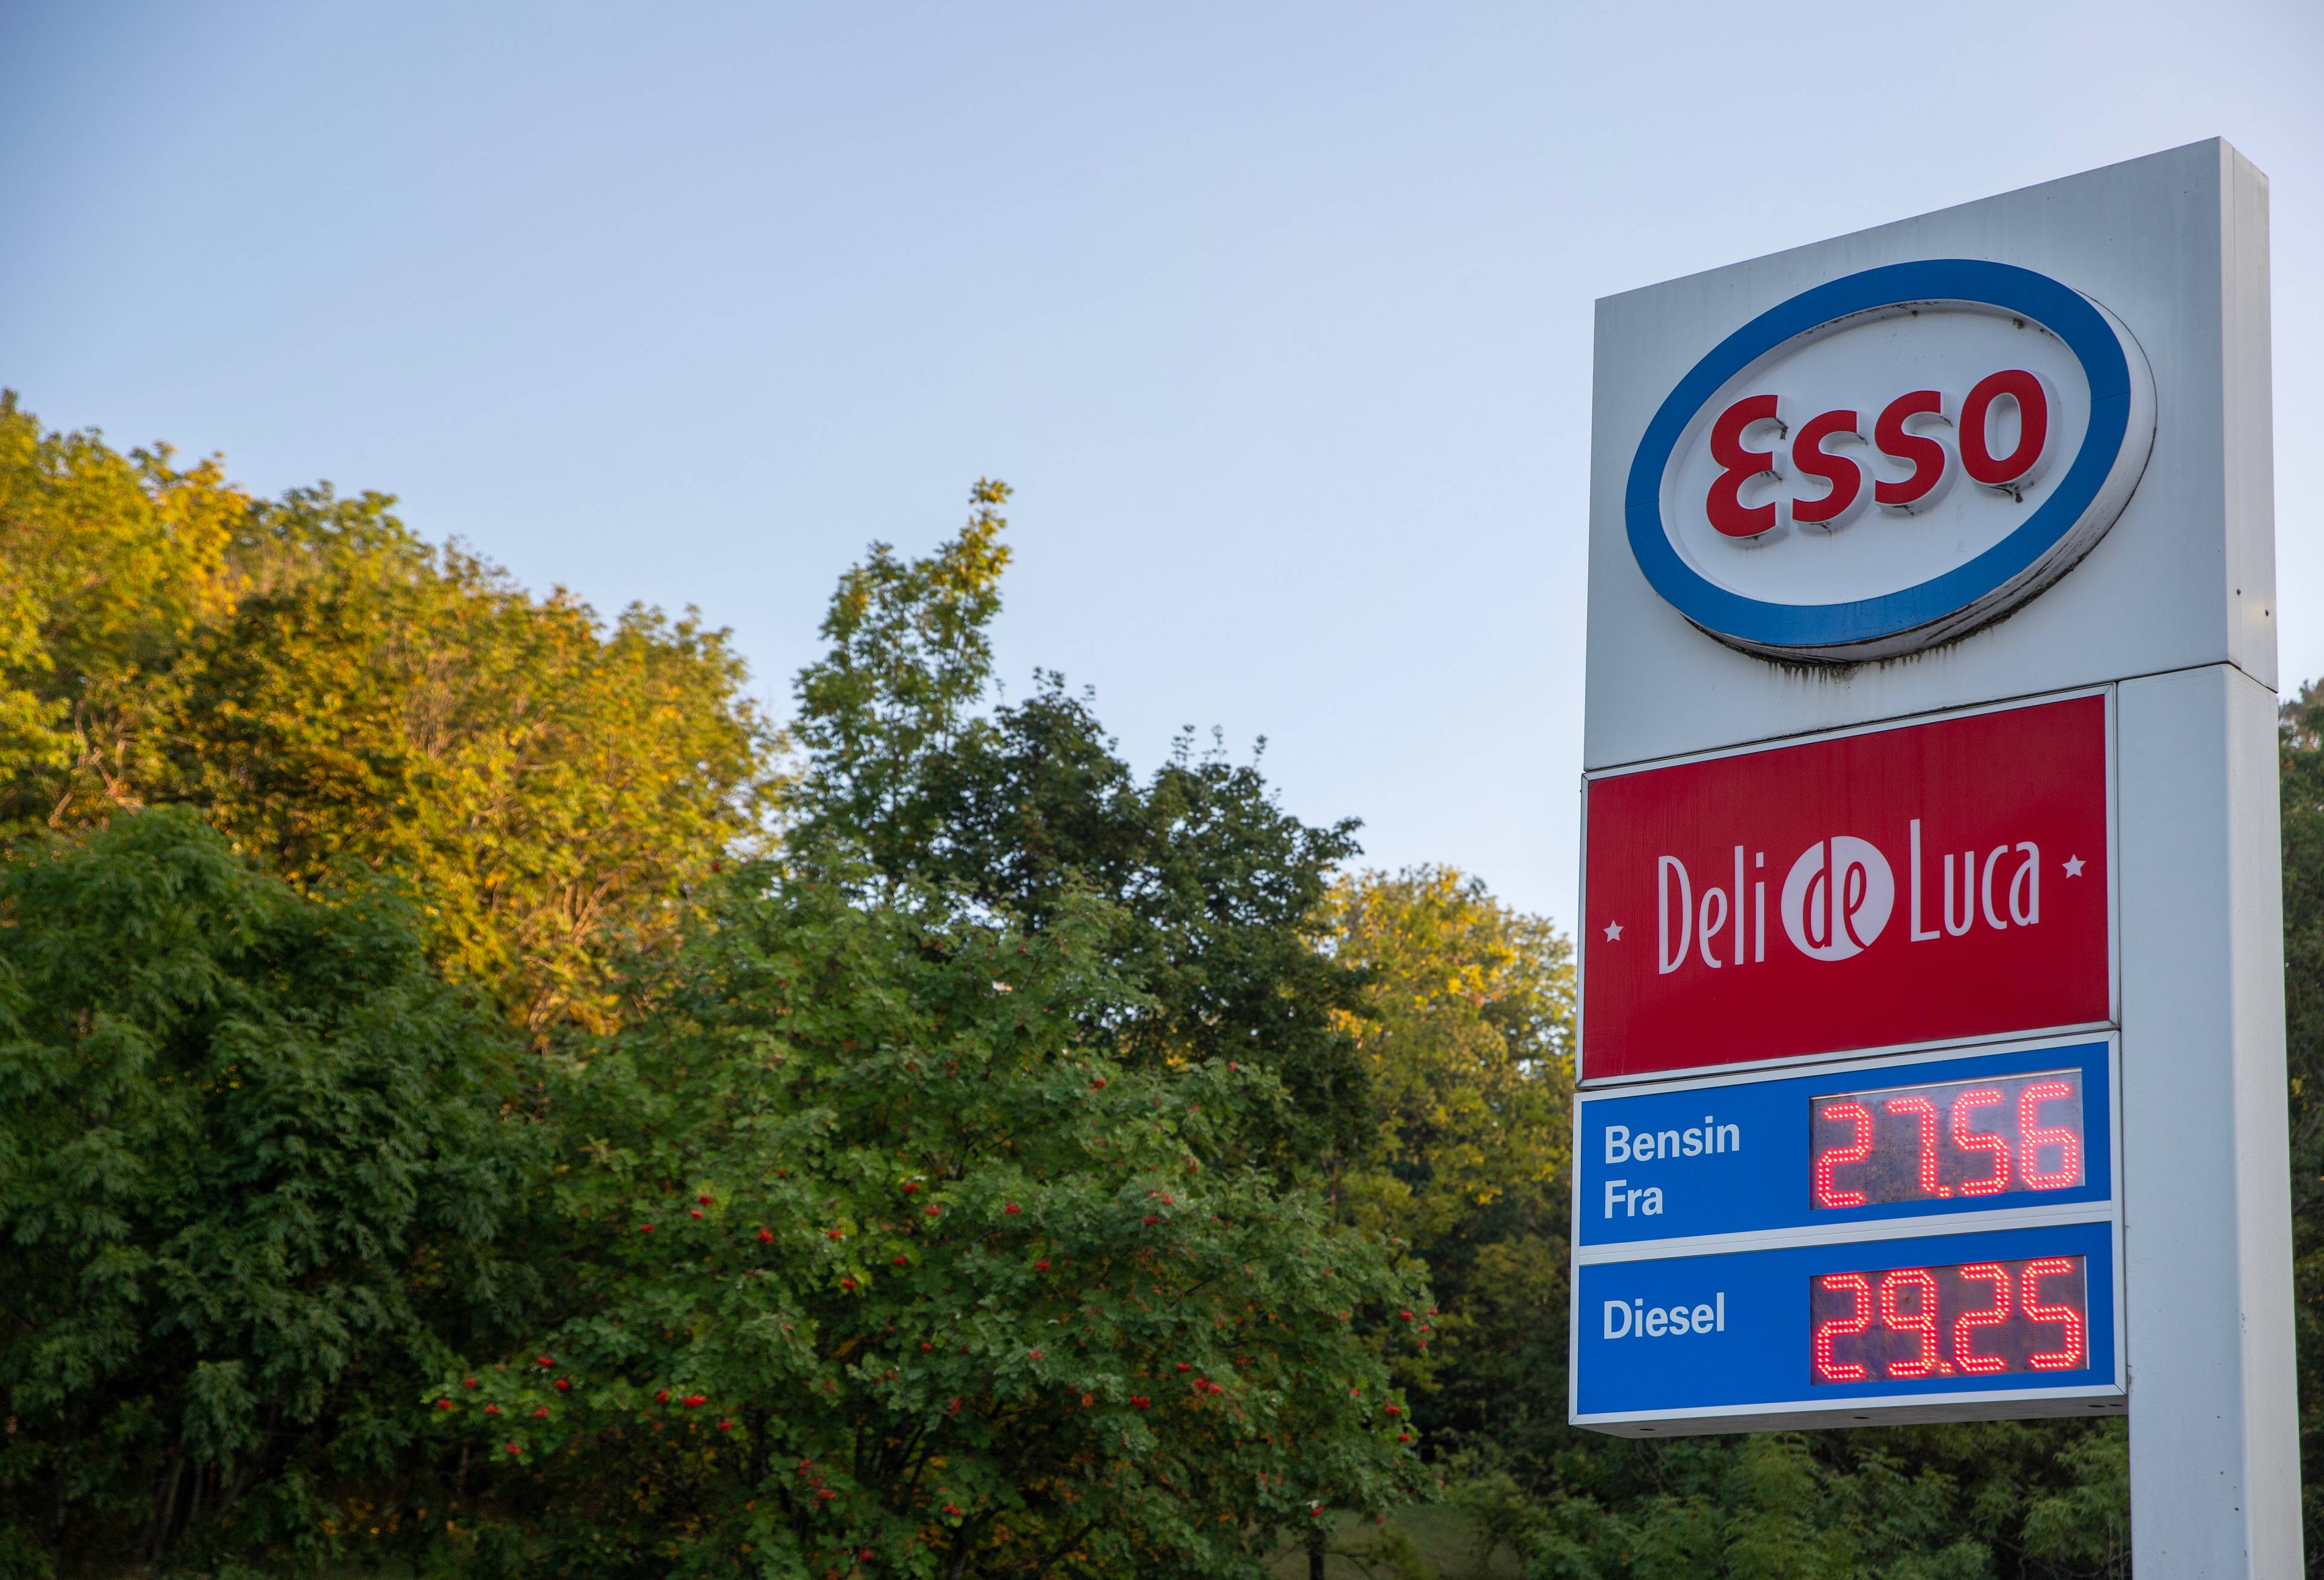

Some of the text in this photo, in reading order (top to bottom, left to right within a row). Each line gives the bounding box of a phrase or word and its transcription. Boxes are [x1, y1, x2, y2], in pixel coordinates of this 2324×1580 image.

[1658, 818, 2040, 975] Deli de Luca
[1606, 1116, 1740, 1164] Bensin
[1816, 1082, 2080, 1207] 27.56
[1604, 1179, 1663, 1219] Fra
[1604, 1292, 1724, 1339] Diesel
[1816, 1259, 2084, 1380] 29.25
